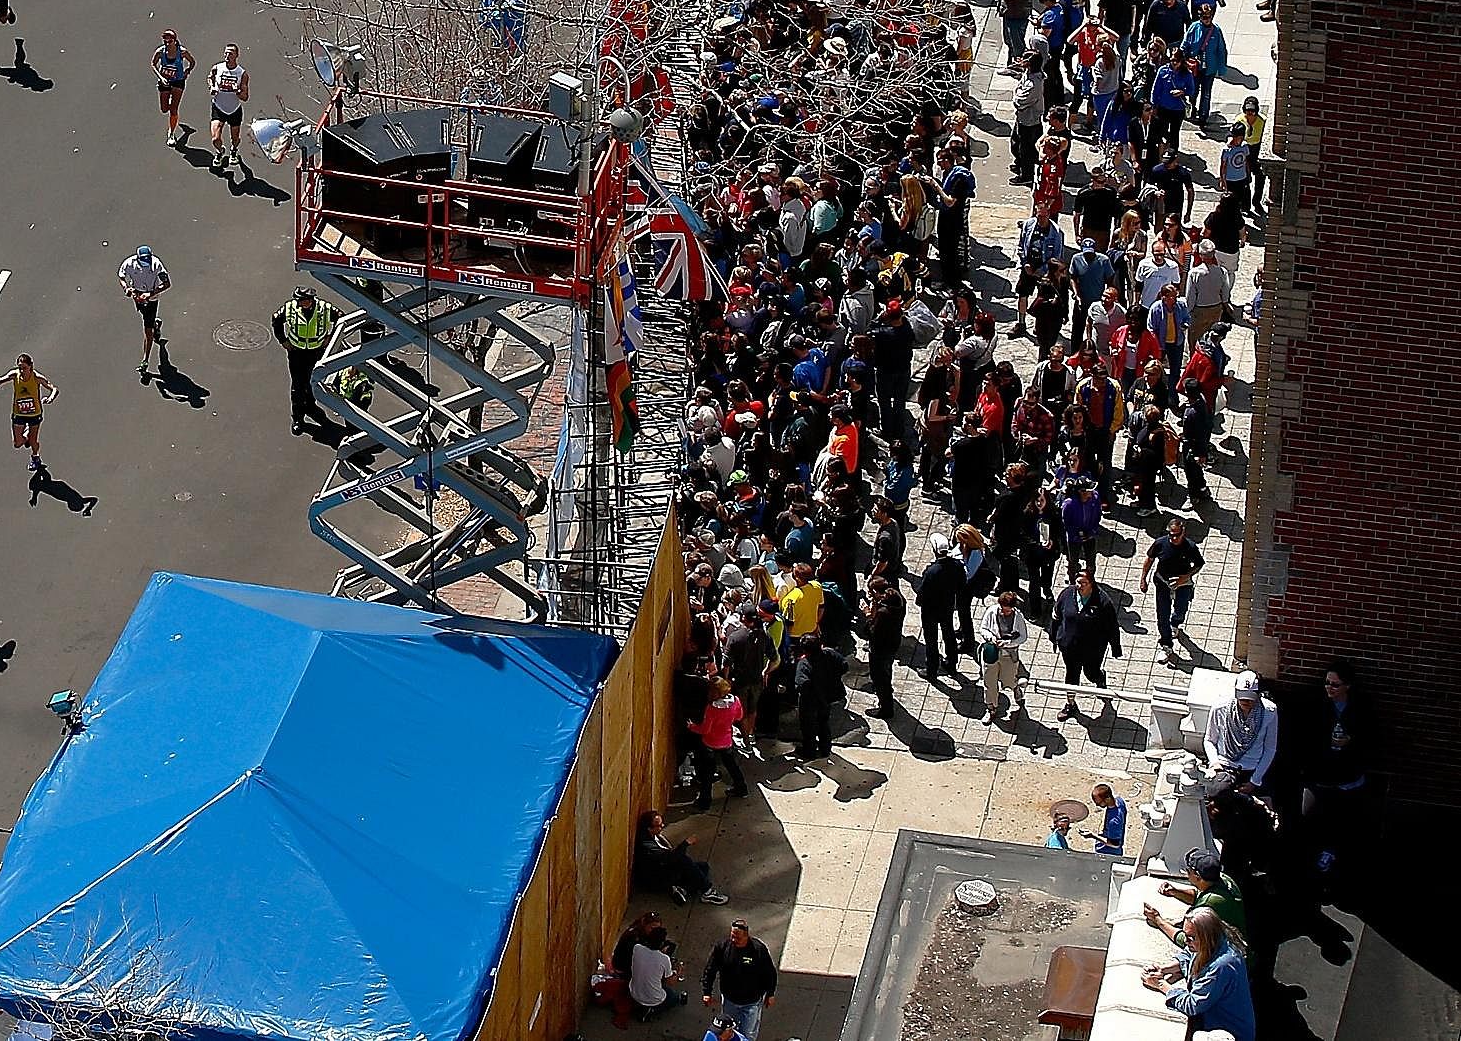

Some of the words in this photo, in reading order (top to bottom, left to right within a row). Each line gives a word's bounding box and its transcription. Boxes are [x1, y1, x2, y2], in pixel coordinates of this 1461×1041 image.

[376, 262, 420, 275] Rentals
[485, 277, 528, 291] Rentals
[361, 472, 401, 492] Rentals
